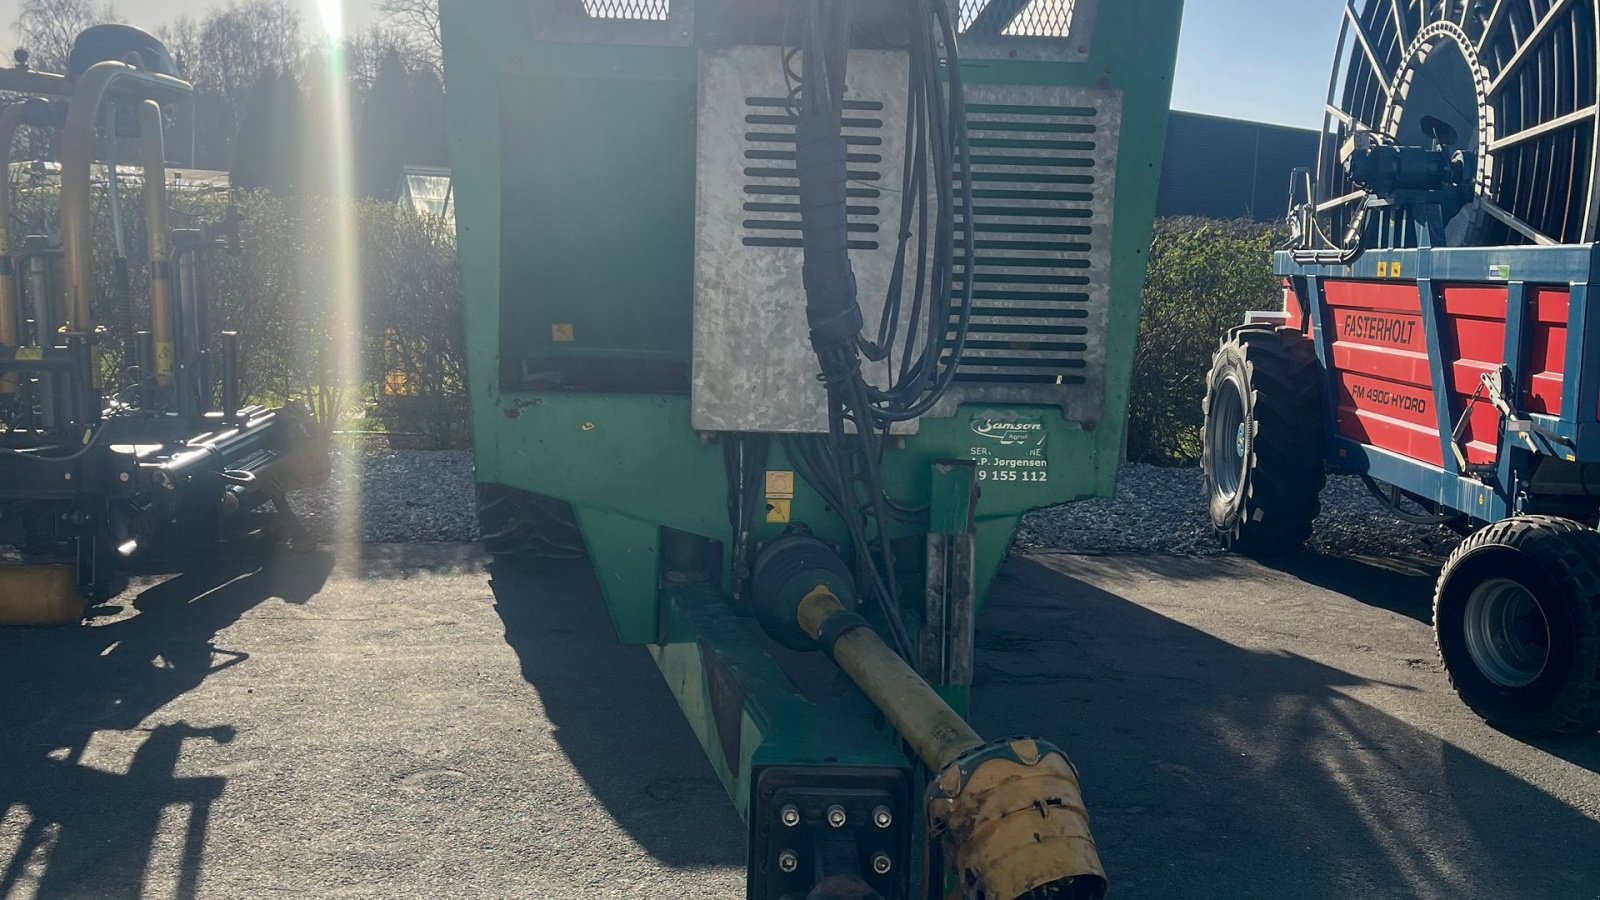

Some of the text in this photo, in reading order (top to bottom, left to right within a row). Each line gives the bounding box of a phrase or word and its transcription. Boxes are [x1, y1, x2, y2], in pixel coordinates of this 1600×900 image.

[1344, 315, 1415, 344] FASTERHOLT
[1352, 385, 1425, 413] FM 4900 HYDRO
[978, 419, 1041, 432] Samson
[973, 457, 1047, 468] .P. Jørgensen
[992, 470, 1017, 481] 155
[1022, 471, 1047, 481] 112
